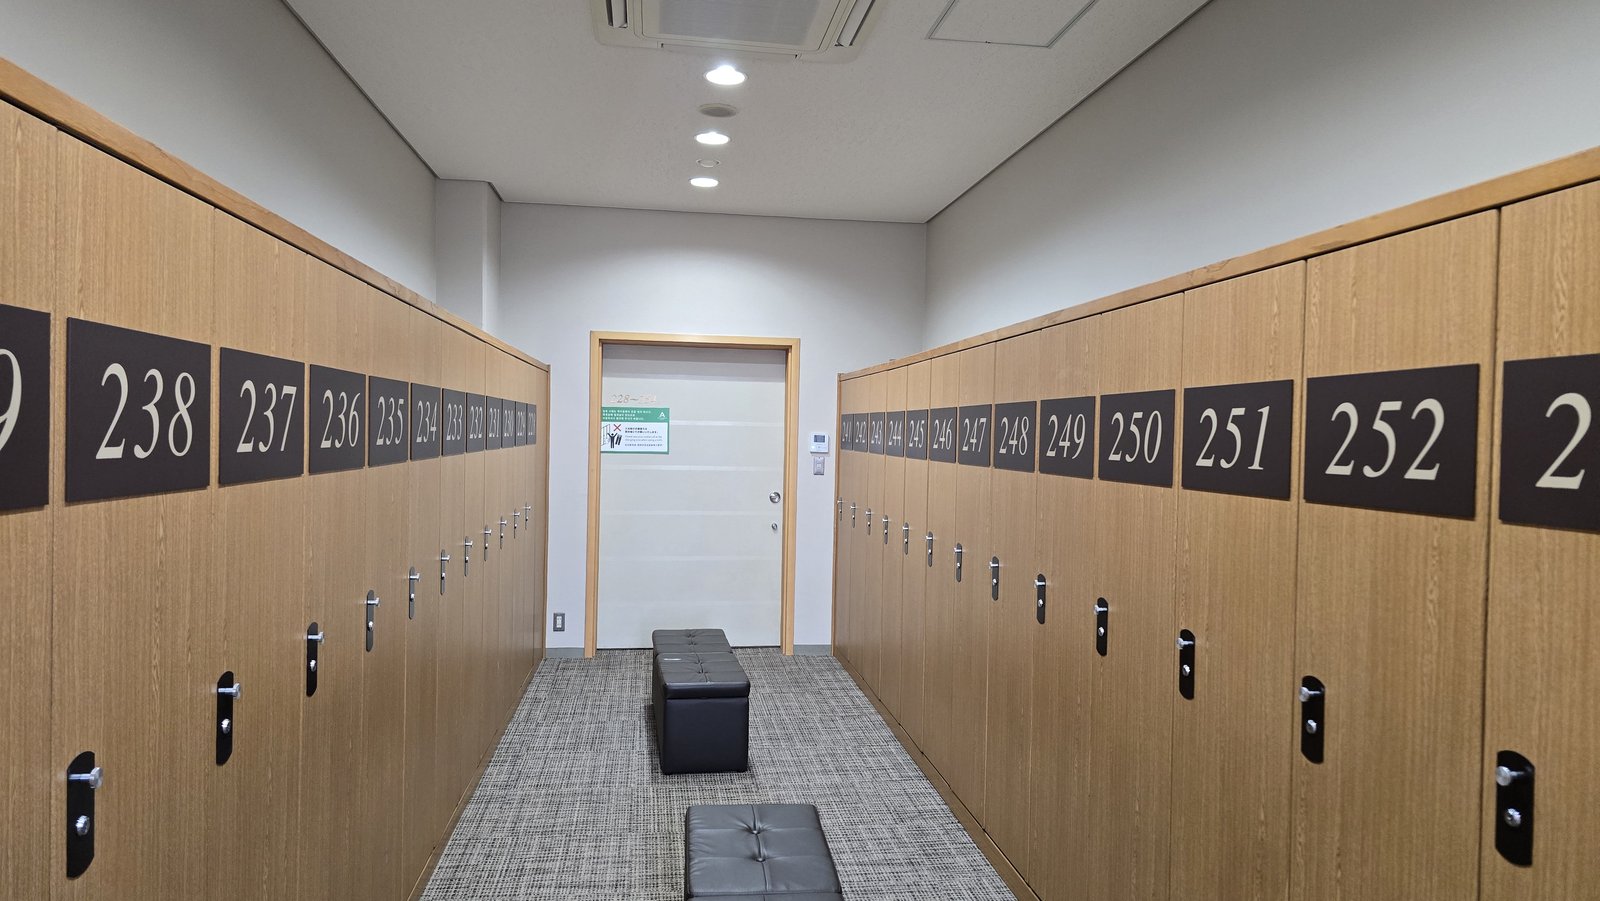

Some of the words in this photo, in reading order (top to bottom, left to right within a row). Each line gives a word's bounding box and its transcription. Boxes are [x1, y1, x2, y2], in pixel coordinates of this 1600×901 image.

[96, 363, 195, 459] 238
[237, 380, 296, 452] 237
[321, 390, 361, 448] 236
[376, 396, 404, 445] 235
[416, 400, 437, 442] 234
[446, 403, 462, 440] 233
[470, 406, 482, 438] 232
[489, 408, 499, 437] 231
[856, 421, 866, 444] 242
[871, 421, 882, 444] 243
[889, 421, 902, 446] 244
[909, 420, 924, 448] 245
[933, 418, 952, 450] 246
[962, 418, 986, 452] 247
[999, 416, 1029, 455] 248
[1046, 414, 1085, 459] 249
[1108, 411, 1162, 463] 250
[1196, 406, 1269, 470] 251
[1326, 398, 1444, 480] 252
